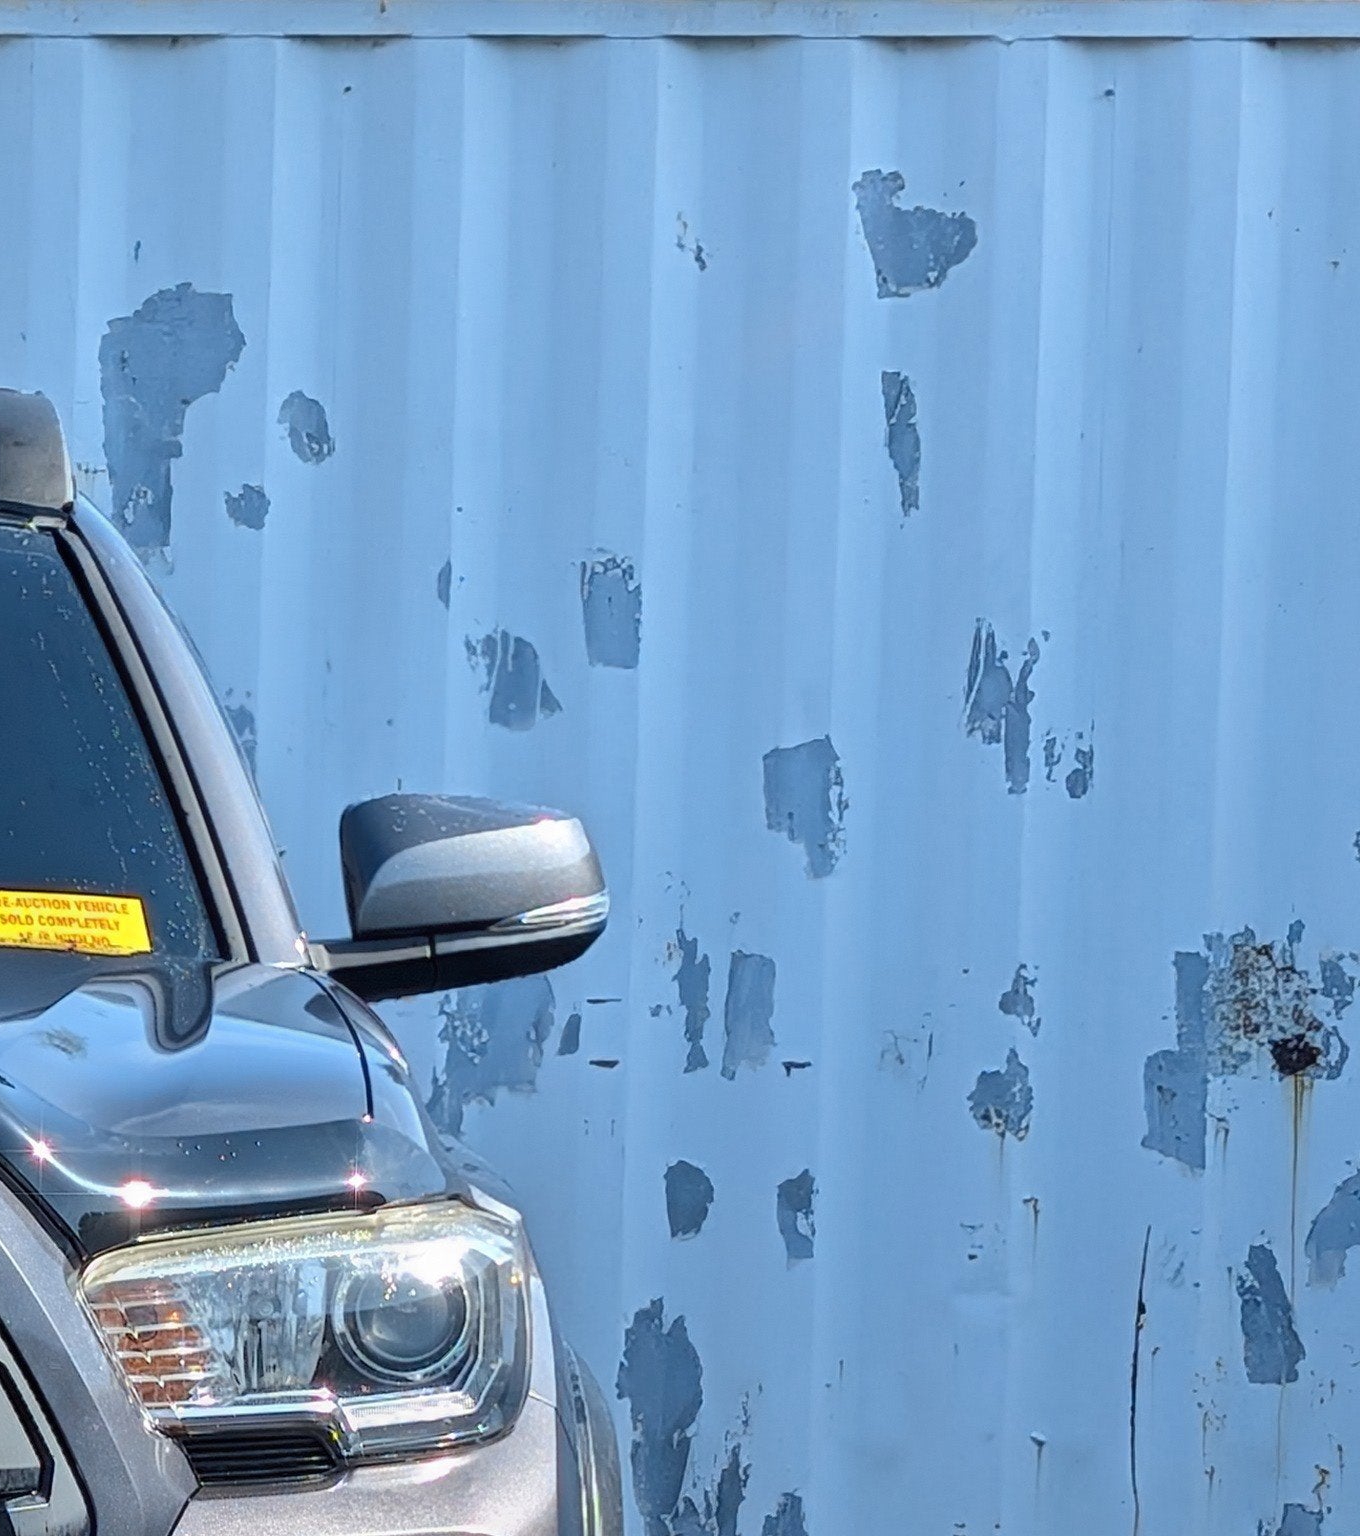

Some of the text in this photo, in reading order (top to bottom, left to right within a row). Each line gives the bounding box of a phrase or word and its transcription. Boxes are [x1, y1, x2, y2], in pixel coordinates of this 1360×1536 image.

[75, 900, 129, 915] VEHICLE
[0, 914, 121, 931] SOLD COMPLETELY
